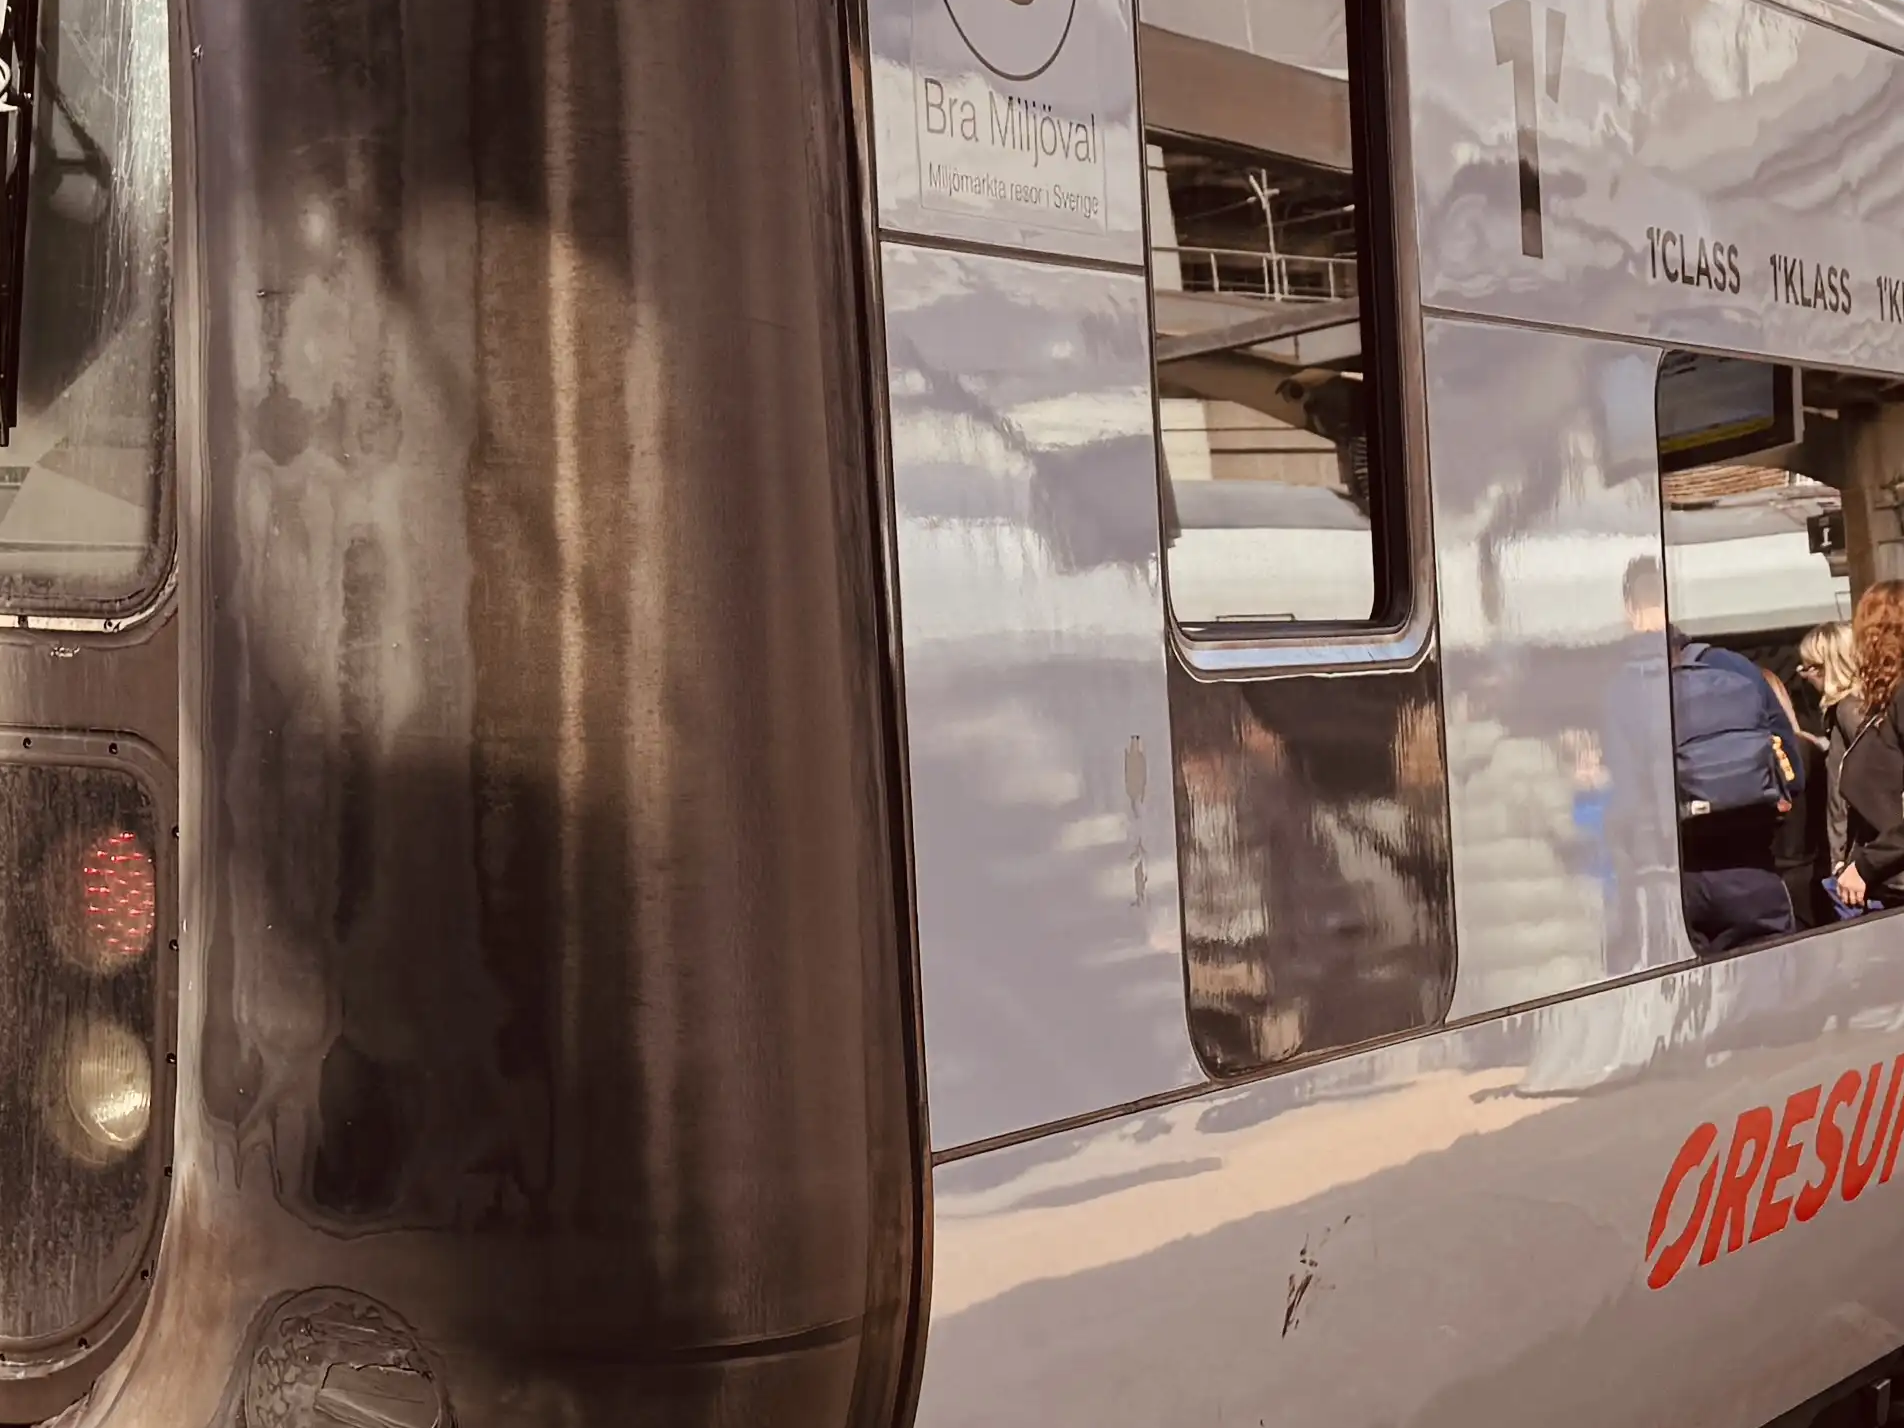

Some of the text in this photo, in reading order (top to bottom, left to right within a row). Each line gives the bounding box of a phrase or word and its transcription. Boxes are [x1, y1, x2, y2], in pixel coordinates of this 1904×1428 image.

[924, 77, 1097, 168] Bra Miljöval
[1010, 181, 1043, 206] resor
[1053, 183, 1100, 219] Sverige
[1645, 226, 1741, 295] 1'CLASS
